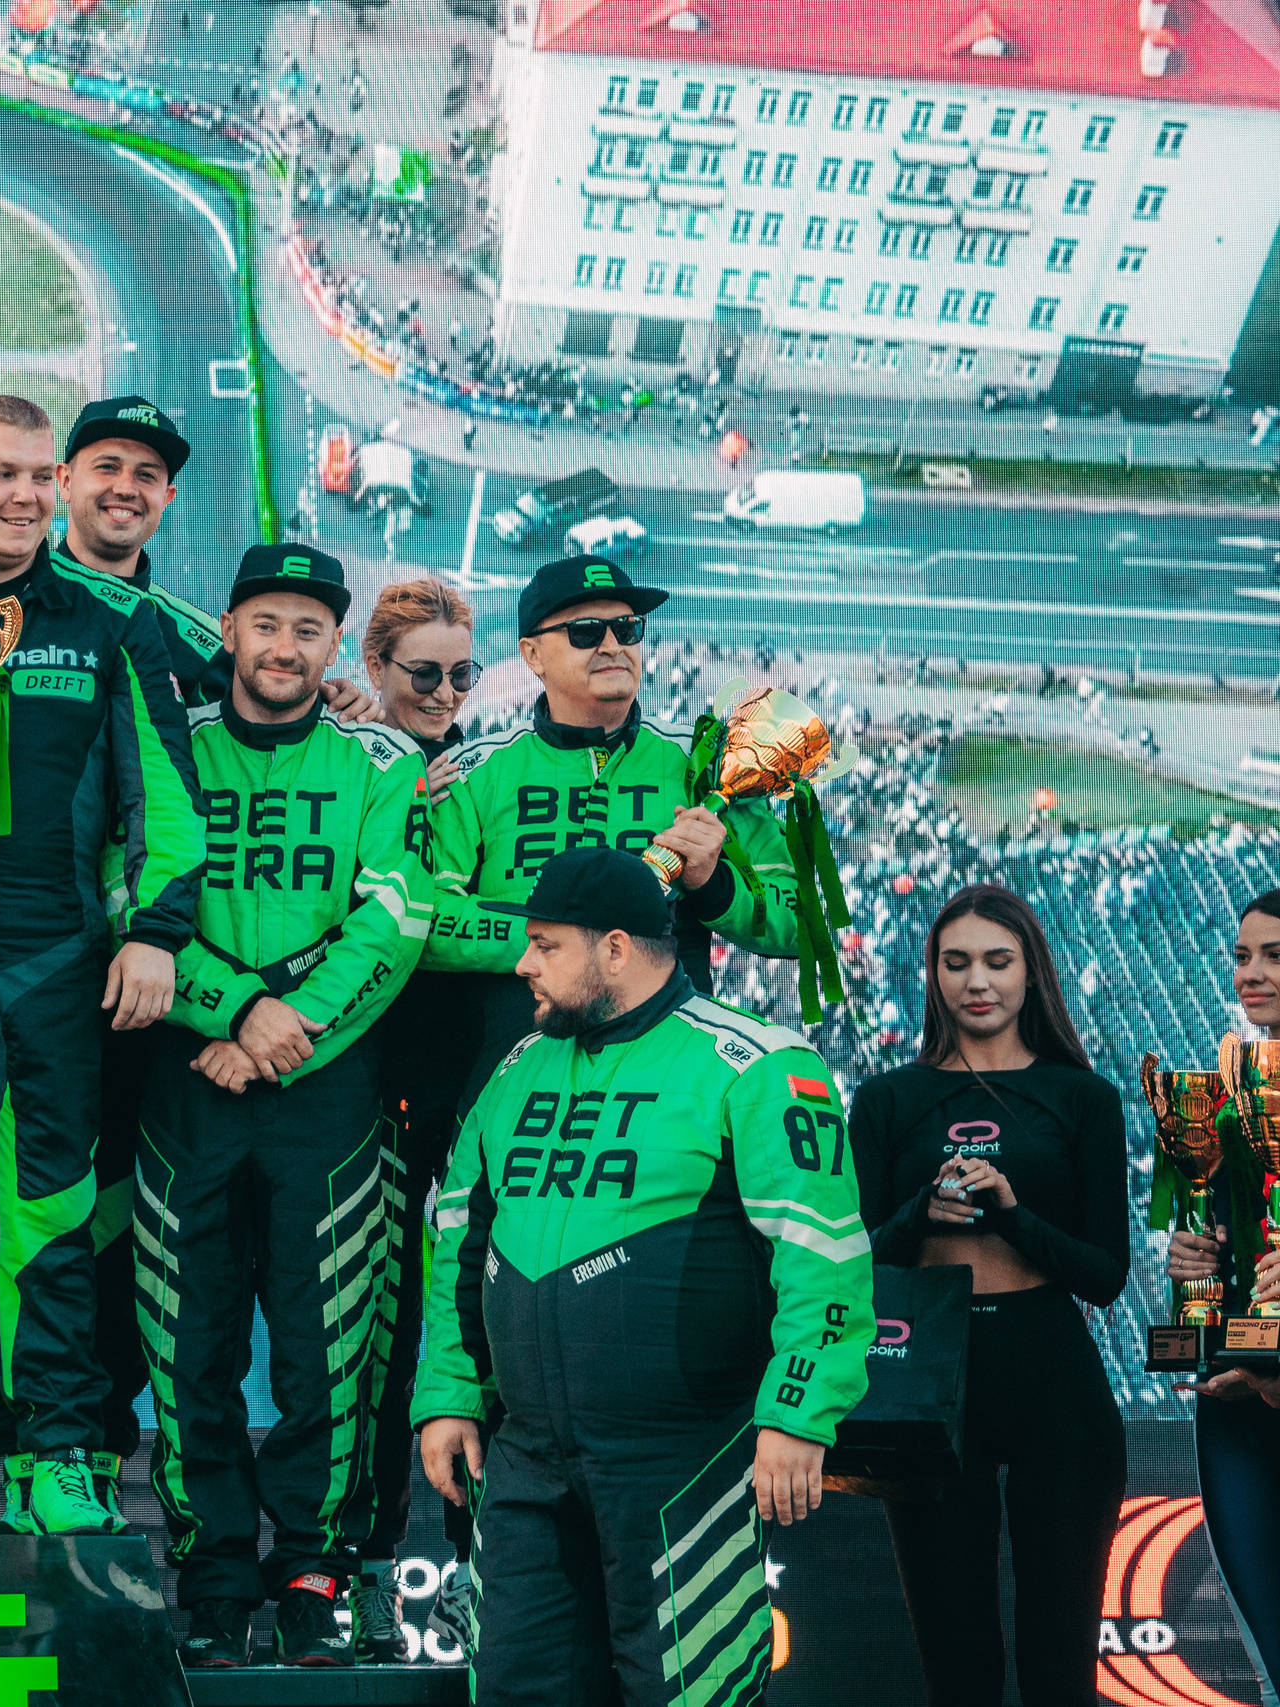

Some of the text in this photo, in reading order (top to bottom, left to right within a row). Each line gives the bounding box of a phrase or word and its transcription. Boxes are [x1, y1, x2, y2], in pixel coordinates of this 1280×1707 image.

[100, 587, 132, 604] OMP
[187, 628, 217, 649] OMP
[25, 675, 87, 694] DRIFT
[370, 741, 393, 761] OMP
[201, 789, 337, 834] BET
[516, 785, 660, 826] BET
[204, 843, 336, 892] ERA
[724, 1042, 751, 1062] OMP
[513, 1090, 659, 1139] BET
[782, 1104, 846, 1176] 87
[494, 1149, 638, 1198] ERA
[572, 1246, 631, 1284] EREMIN V.
[1260, 1321, 1278, 1331] GP
[303, 1574, 330, 1590] OMP
